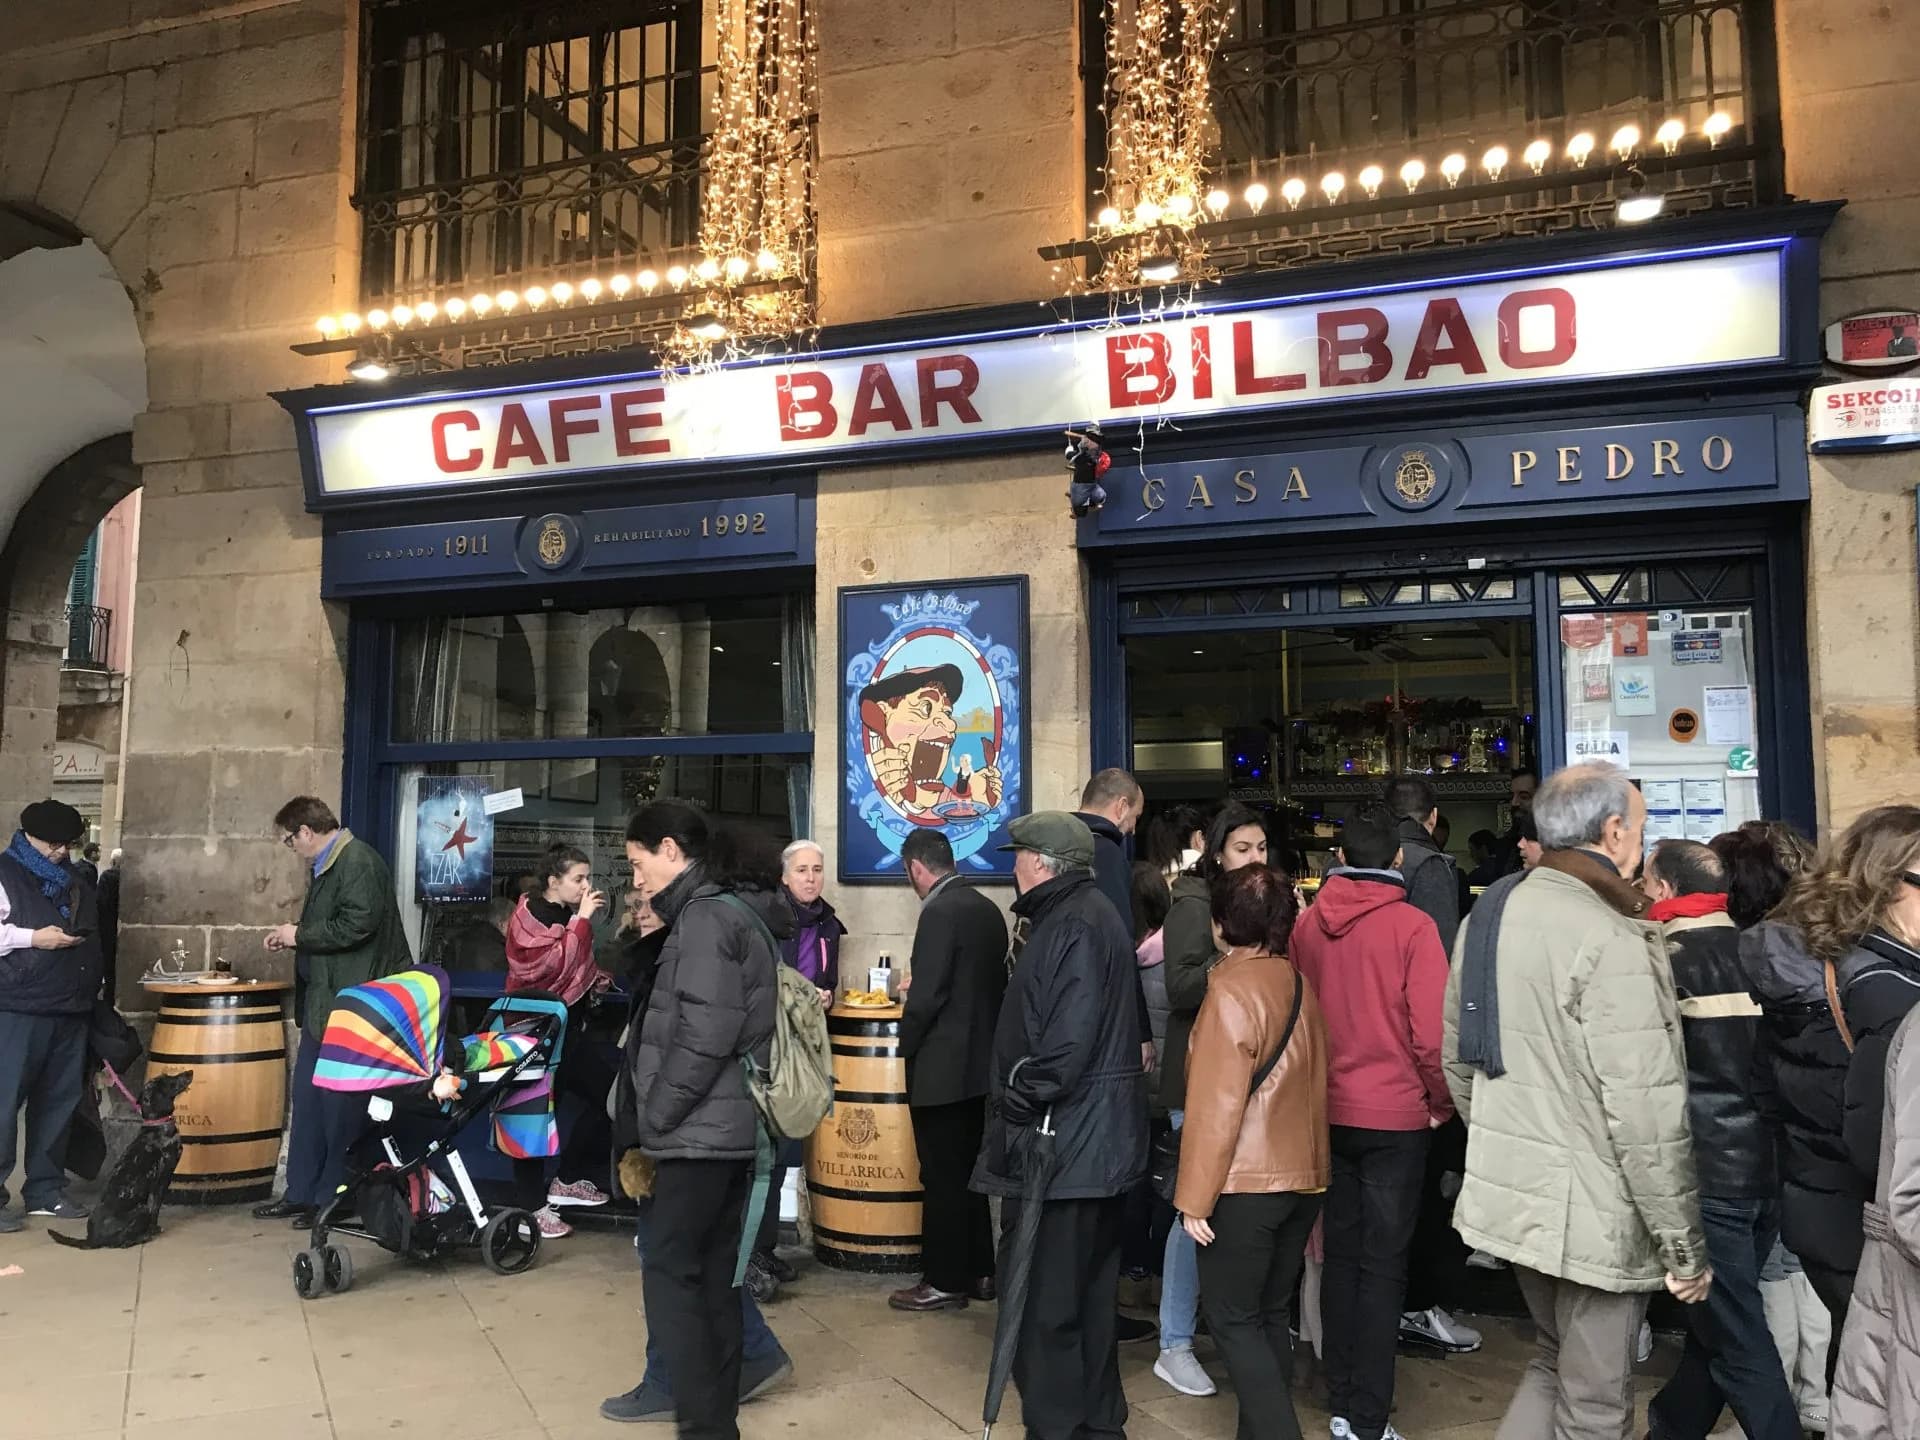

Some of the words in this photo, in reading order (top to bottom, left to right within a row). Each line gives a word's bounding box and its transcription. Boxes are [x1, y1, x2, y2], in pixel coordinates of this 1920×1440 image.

[431, 387, 671, 474] CAFE
[775, 353, 983, 442] BAR
[1105, 287, 1577, 409] BILBAO
[1141, 466, 1312, 511] CASA
[1510, 435, 1734, 487] PEDRO
[594, 527, 690, 544] REHABILITADO
[700, 512, 767, 537] 1992
[444, 534, 489, 557] 1911
[926, 595, 972, 615] Bilbao
[515, 1050, 538, 1073] COSATTO
[817, 1160, 904, 1179] VILLARRICA
[844, 1180, 869, 1189] RIOJA
